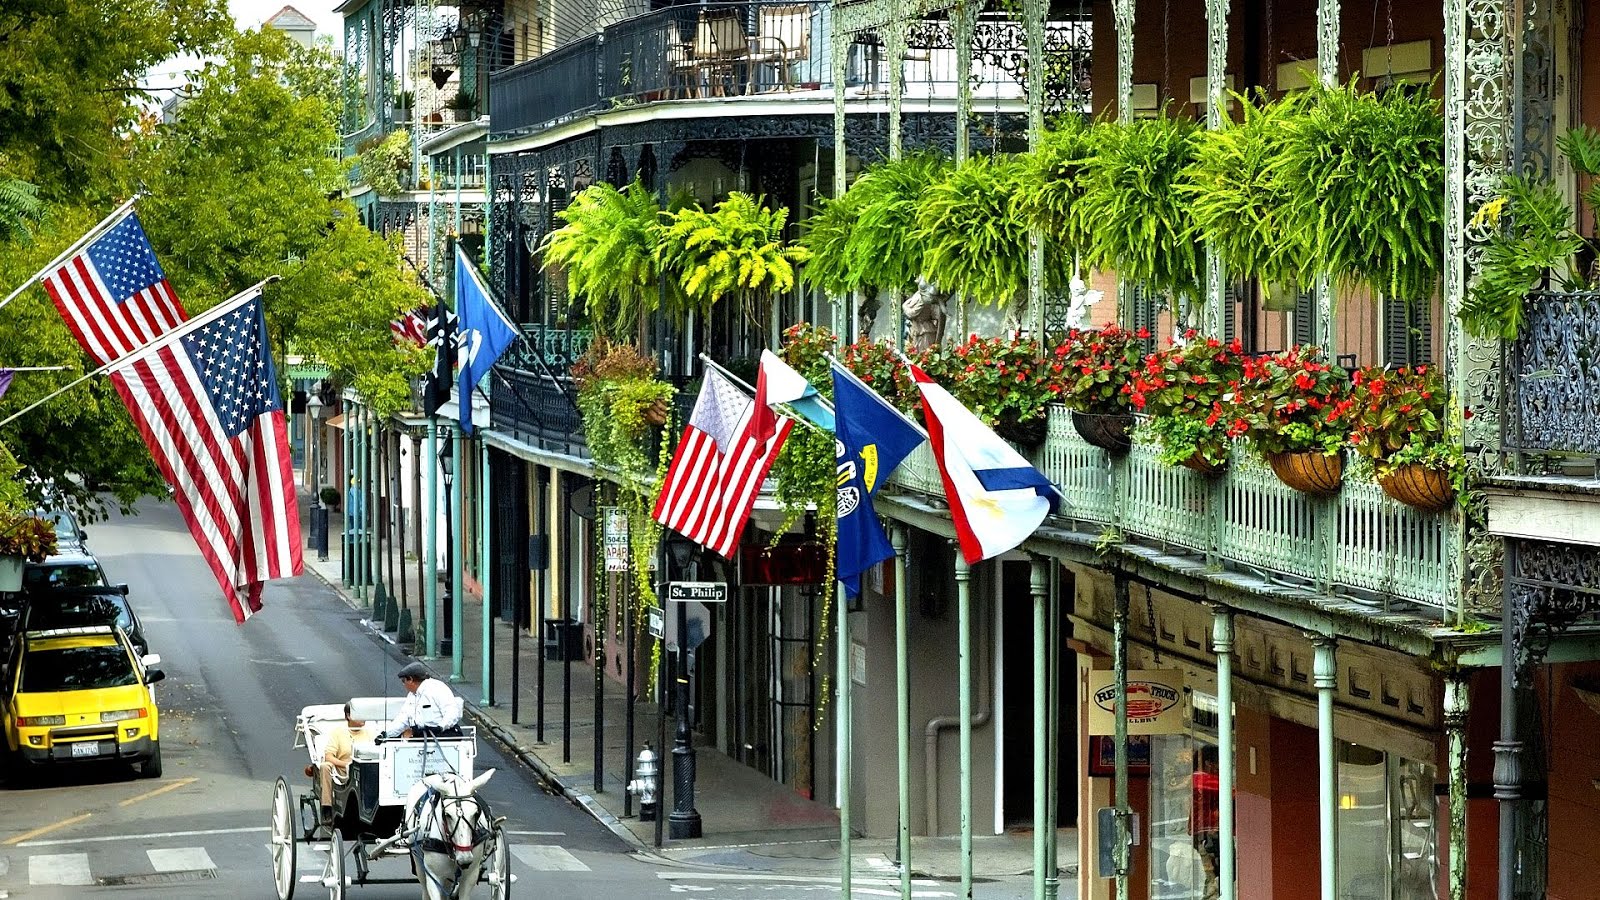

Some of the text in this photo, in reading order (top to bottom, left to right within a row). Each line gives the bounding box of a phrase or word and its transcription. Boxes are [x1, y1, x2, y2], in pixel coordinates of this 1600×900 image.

[672, 587, 723, 600] St. Philip
[1096, 685, 1177, 703] RE TRUCK
